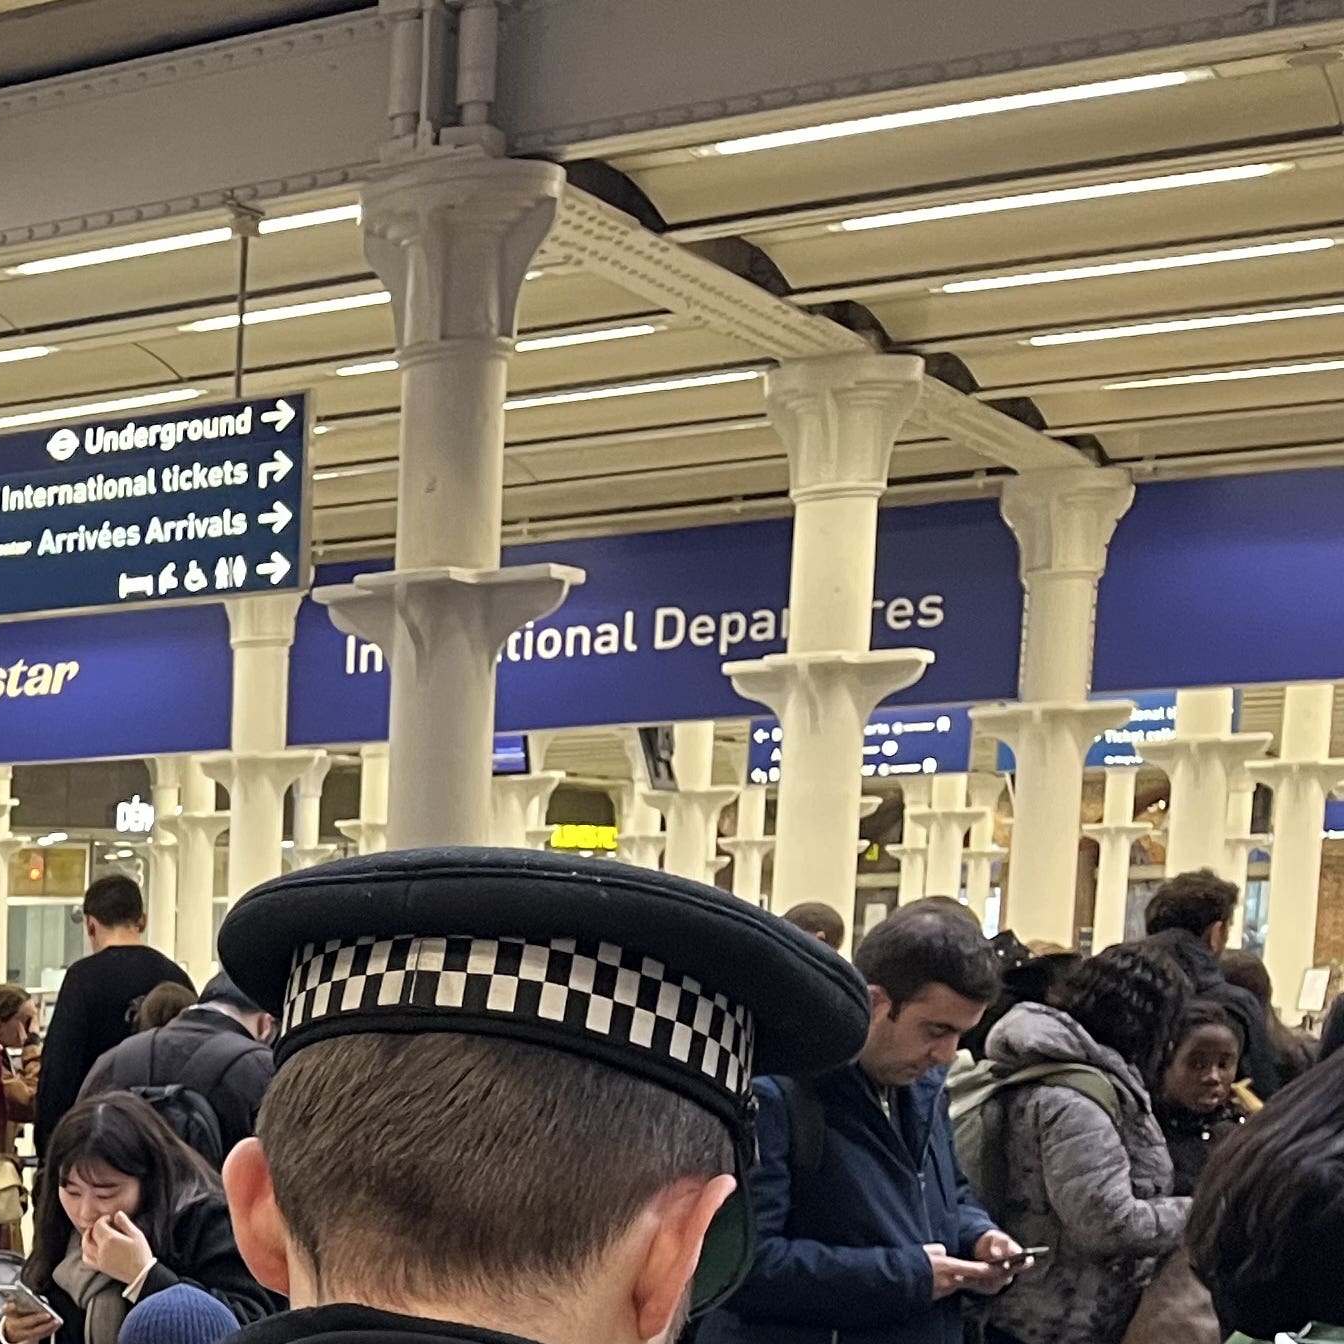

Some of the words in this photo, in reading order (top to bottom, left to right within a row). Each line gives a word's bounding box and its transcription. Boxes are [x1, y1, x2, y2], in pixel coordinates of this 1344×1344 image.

[85, 406, 252, 455] Underground
[1, 468, 156, 512] International
[162, 458, 249, 491] tickets
[37, 520, 141, 557] Arrivées
[145, 508, 248, 545] Arrivals
[345, 610, 638, 675] Intional
